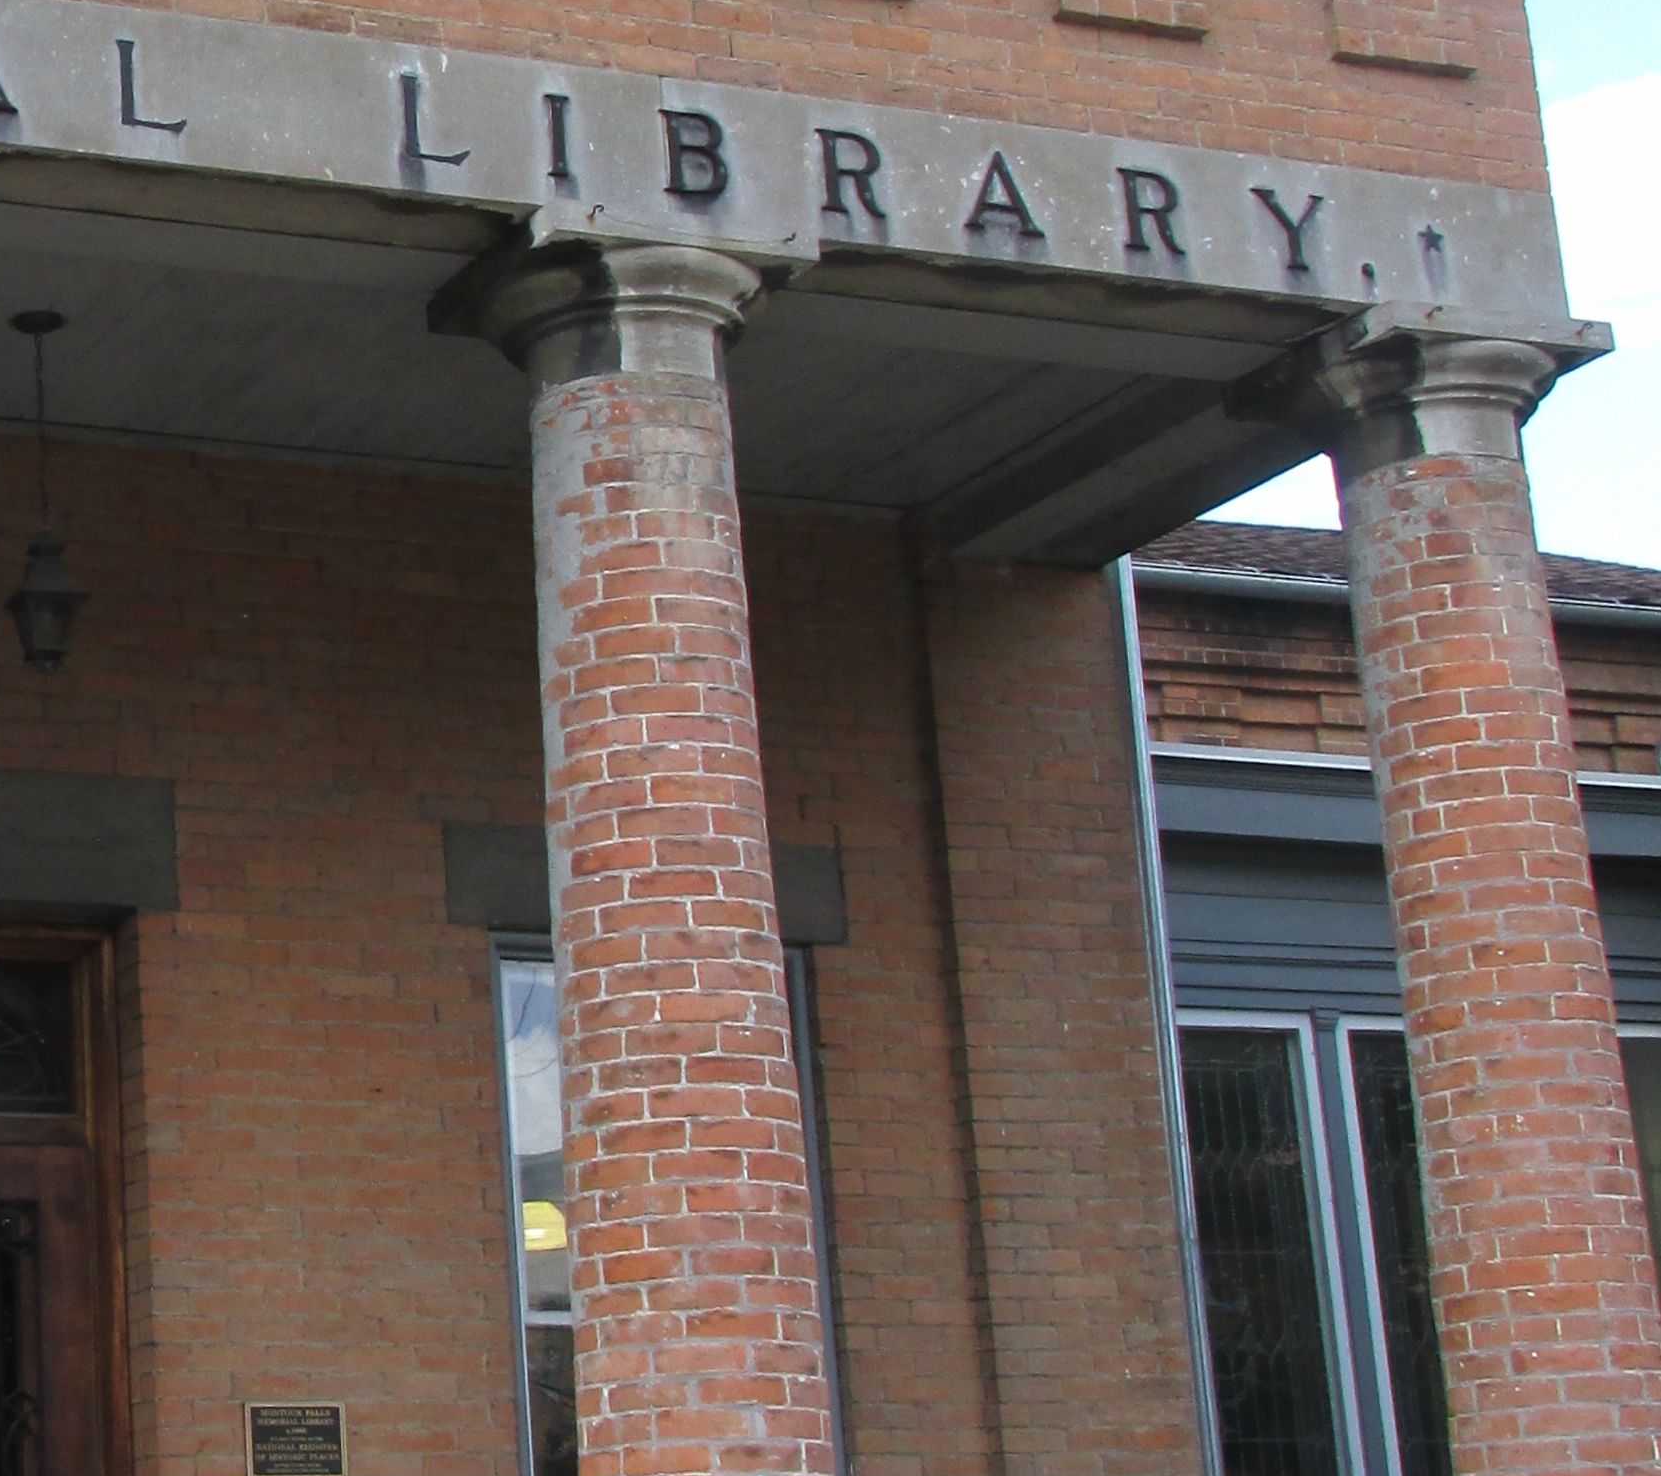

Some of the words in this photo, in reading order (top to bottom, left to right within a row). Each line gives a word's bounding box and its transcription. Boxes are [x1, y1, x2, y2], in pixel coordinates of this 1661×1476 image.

[305, 1409, 331, 1417] FALLS
[257, 1418, 299, 1426] MEMORIAL
[301, 1418, 334, 1426] LIBRARY
[256, 1443, 297, 1451] NATIONAL
